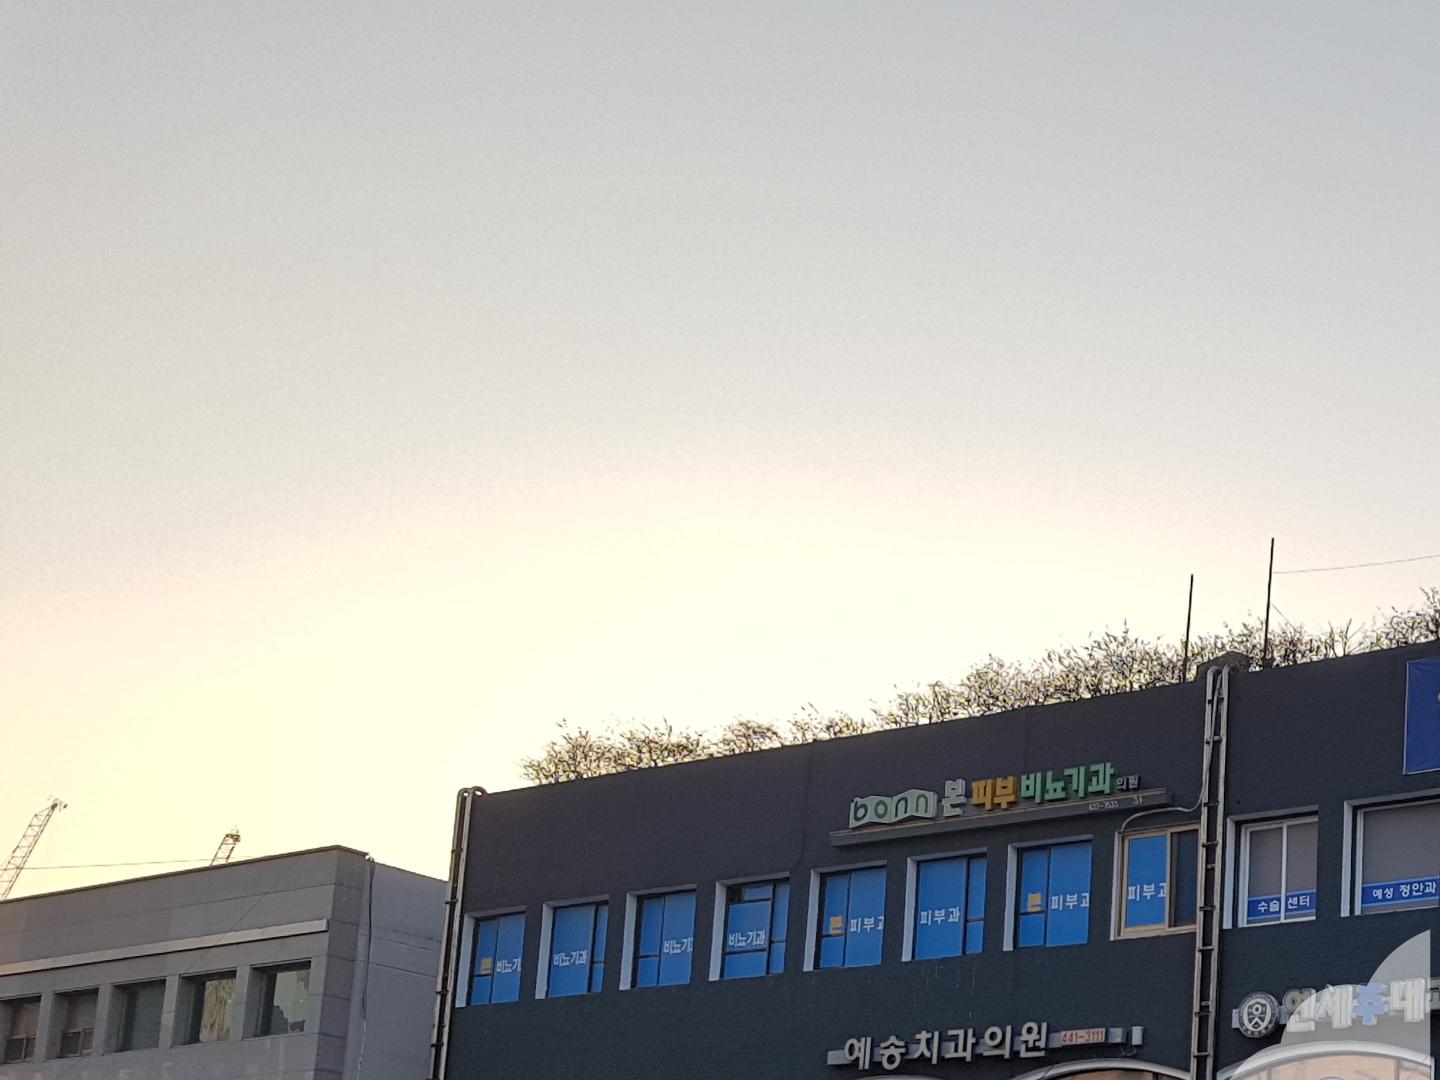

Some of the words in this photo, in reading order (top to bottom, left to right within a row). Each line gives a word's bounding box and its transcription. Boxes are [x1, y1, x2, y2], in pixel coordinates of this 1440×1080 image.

[920, 907, 960, 925] 피부과
[663, 937, 693, 955] 비뇨기
[729, 930, 765, 947] 비뇨기과
[553, 949, 587, 966] 비뇨기과
[843, 1022, 1048, 1071] 예송치과의원
